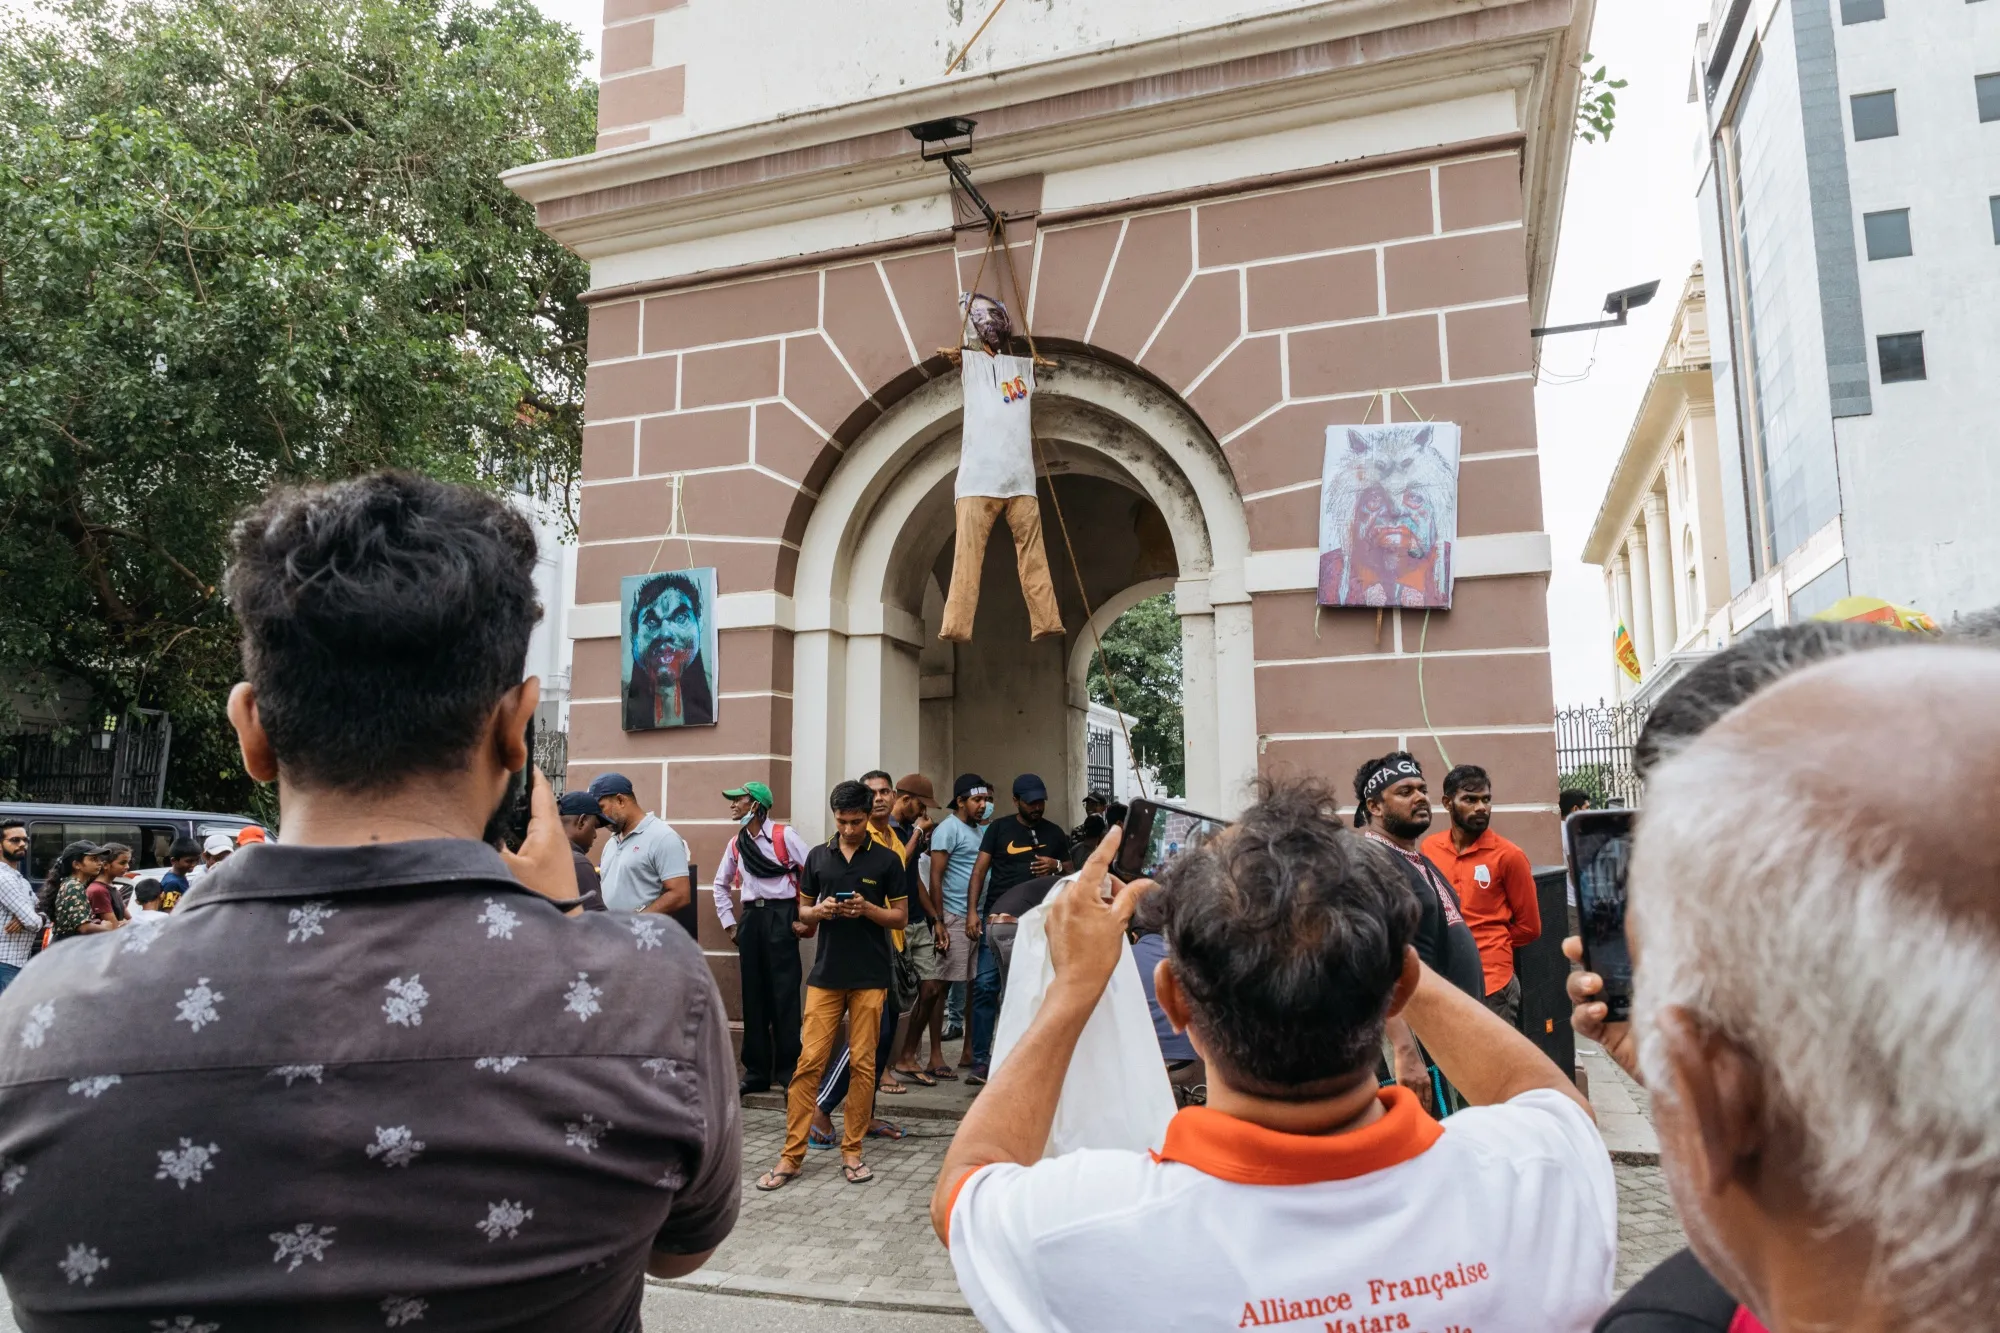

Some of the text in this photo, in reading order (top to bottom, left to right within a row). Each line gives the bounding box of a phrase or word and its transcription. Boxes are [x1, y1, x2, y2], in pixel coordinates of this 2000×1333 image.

[1238, 1261, 1489, 1329] Alliance Française
[1324, 1311, 1411, 1333] Matara
